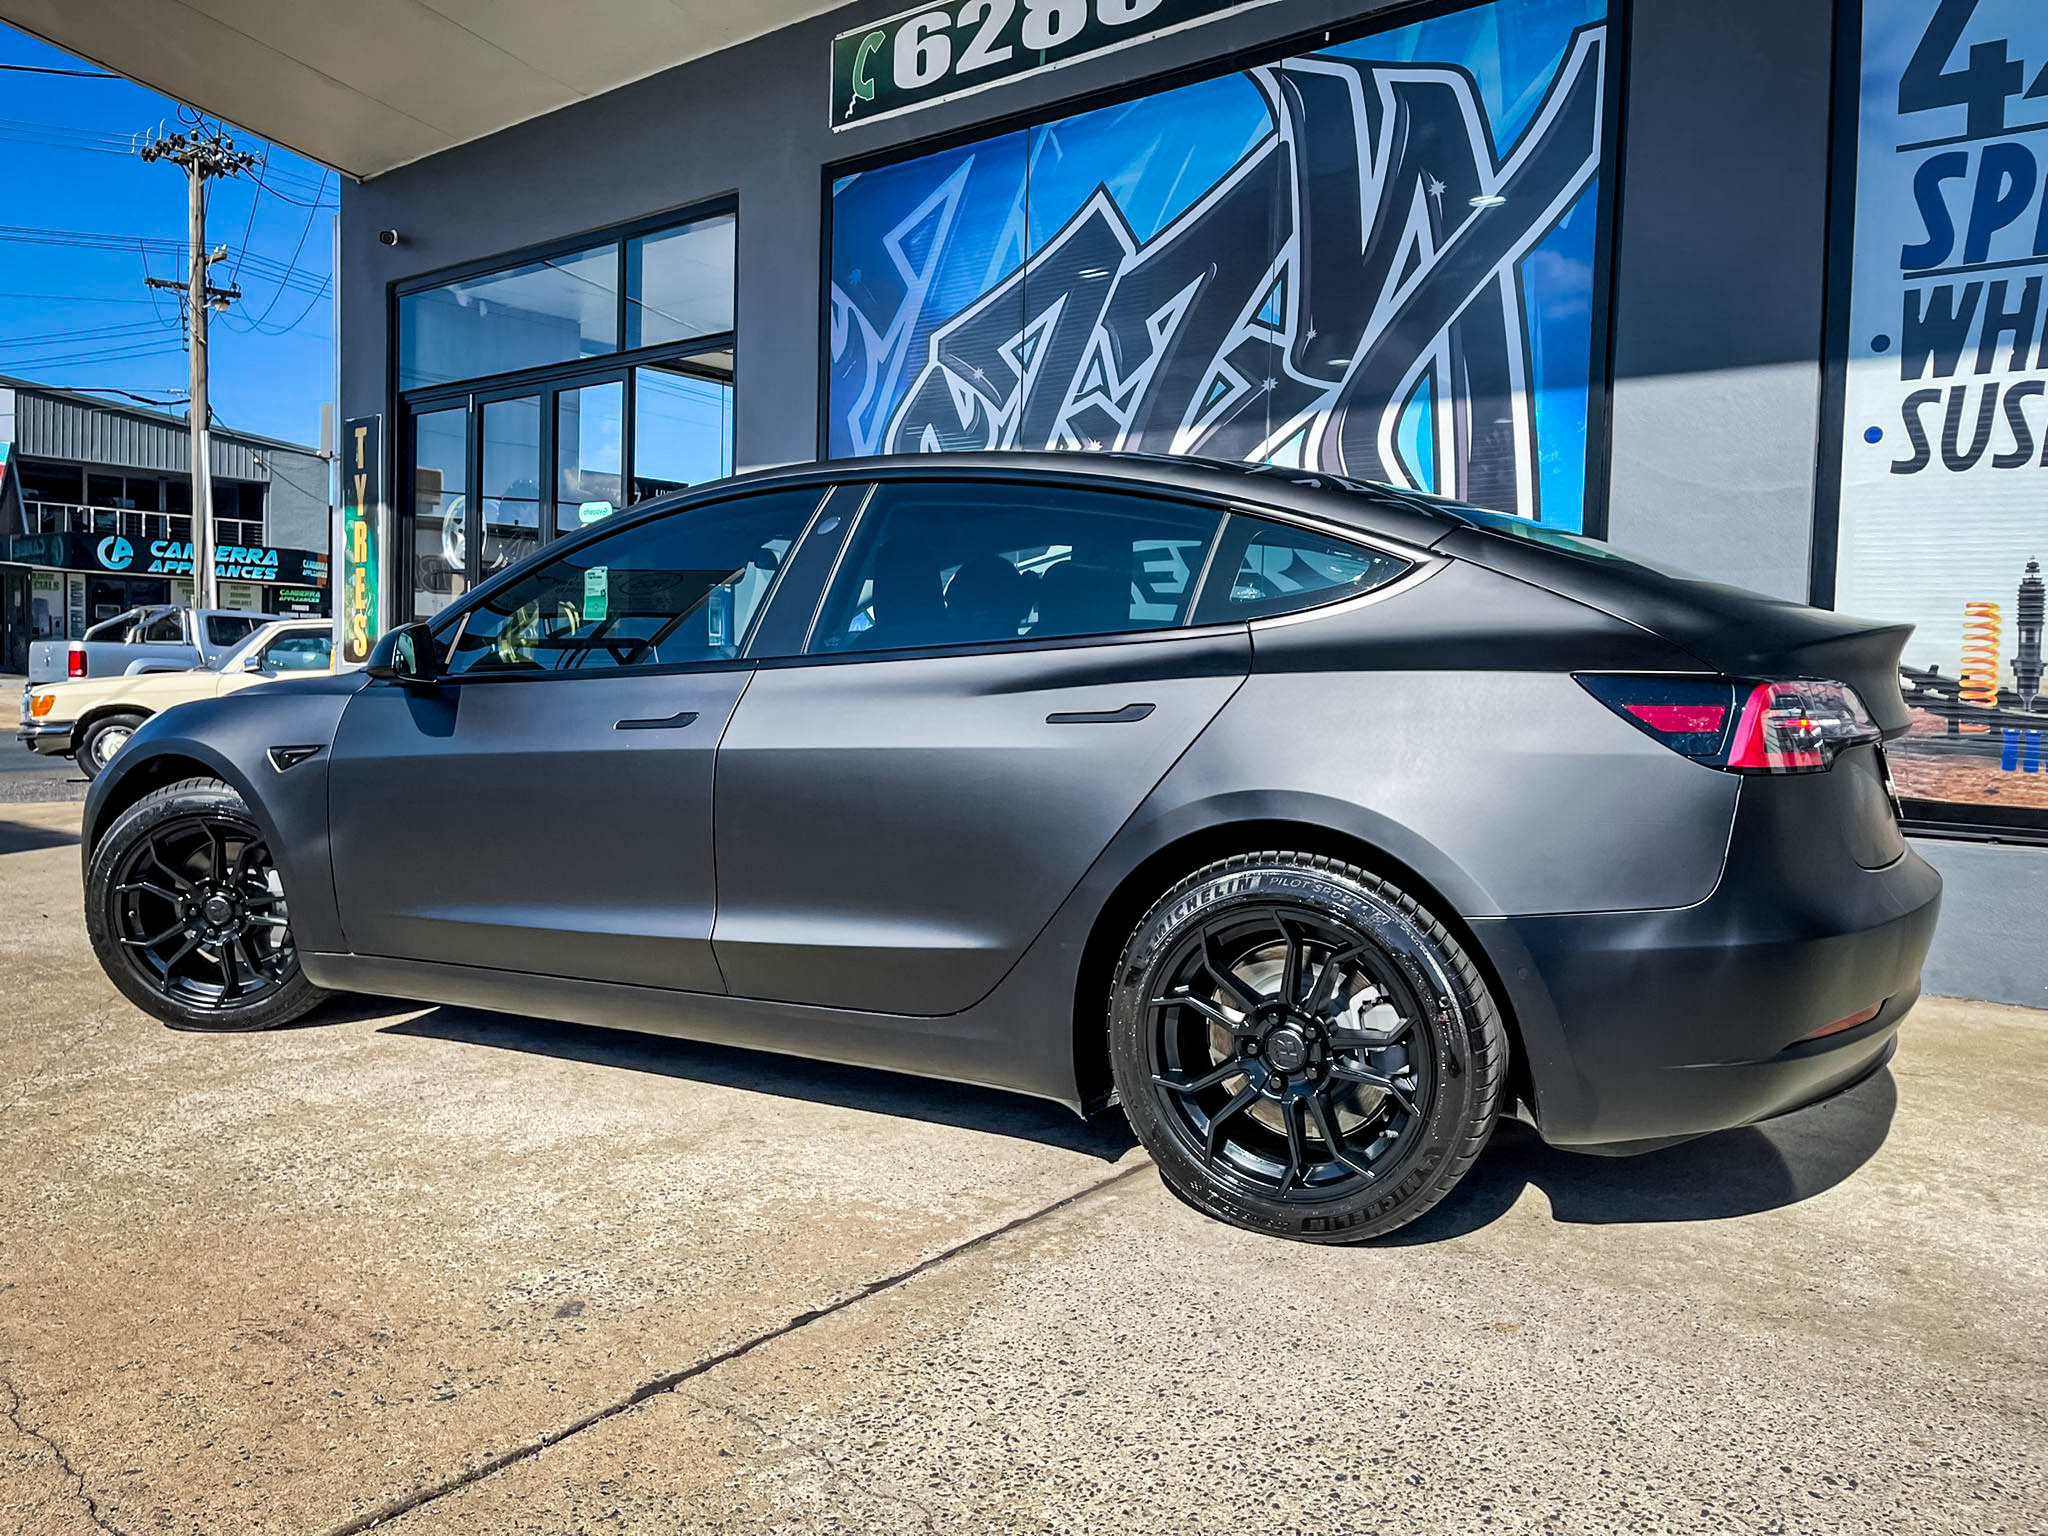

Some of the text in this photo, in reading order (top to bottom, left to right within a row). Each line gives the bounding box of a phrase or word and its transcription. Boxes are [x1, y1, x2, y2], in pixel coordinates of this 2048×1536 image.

[1898, 0, 2048, 137] 4
[1900, 142, 2048, 270] SP
[1900, 276, 2048, 381] WH
[1890, 380, 2048, 474] SUS
[147, 559, 278, 580] APPANCES
[150, 540, 279, 566] CANERRA
[353, 426, 368, 657] TYRES
[1270, 877, 1311, 889] PILOT
